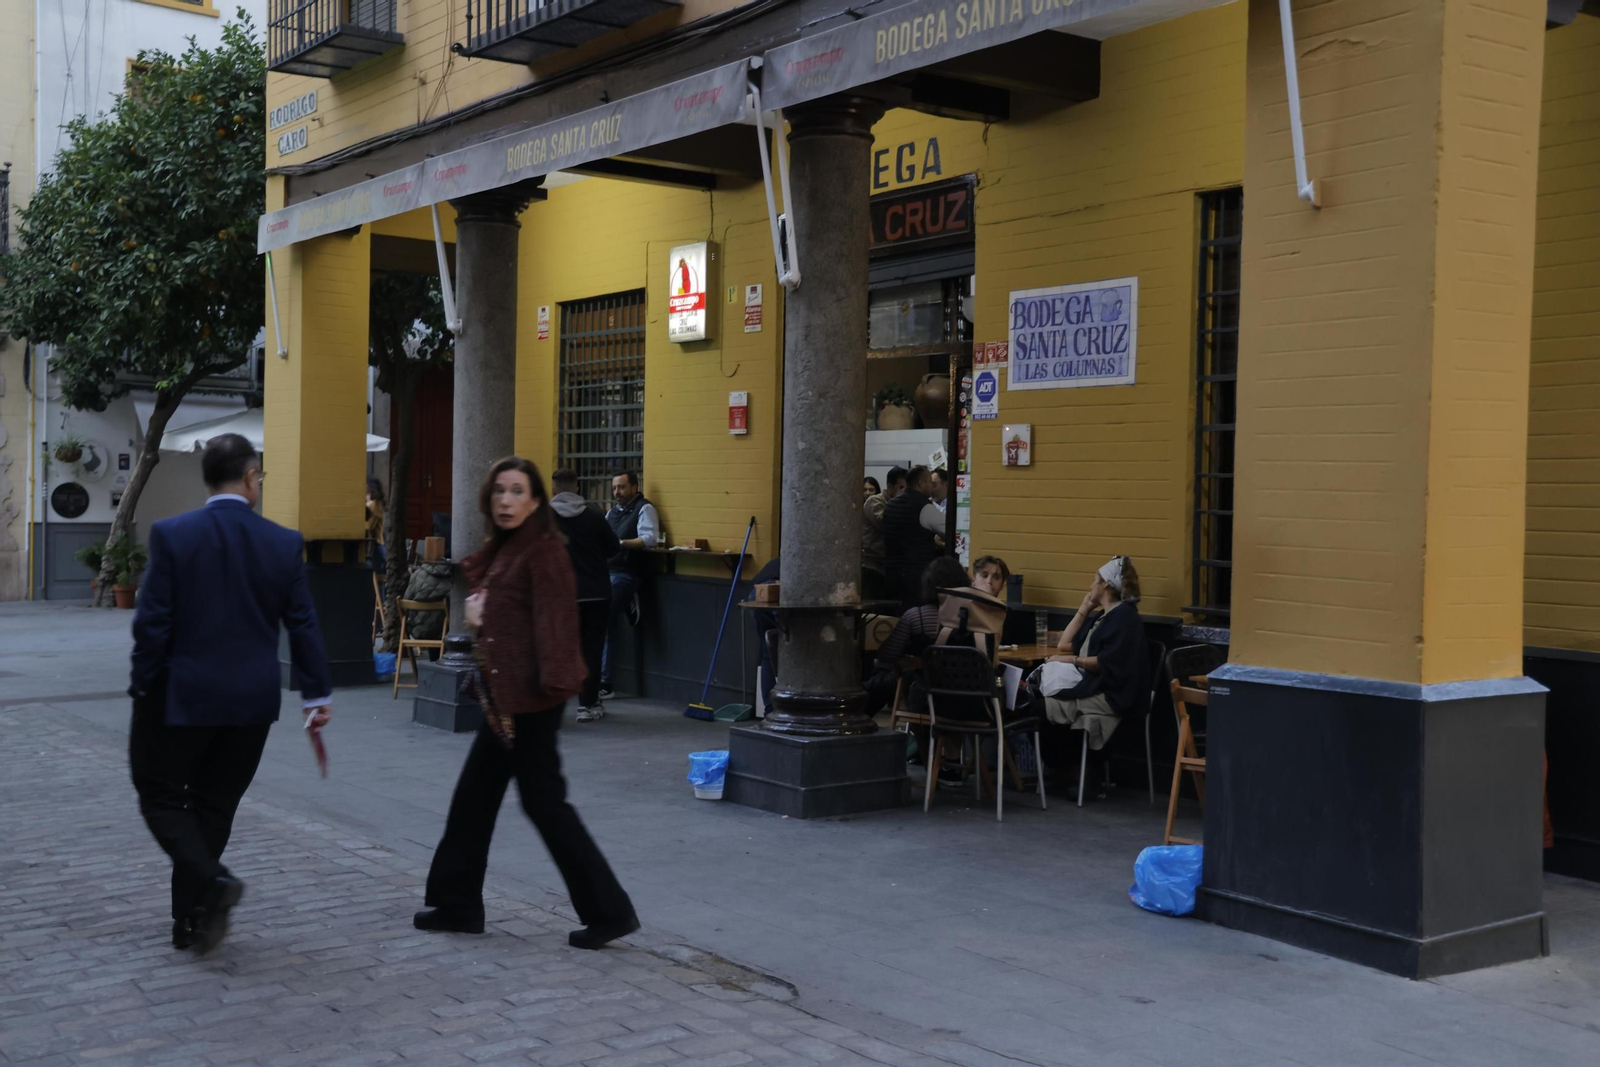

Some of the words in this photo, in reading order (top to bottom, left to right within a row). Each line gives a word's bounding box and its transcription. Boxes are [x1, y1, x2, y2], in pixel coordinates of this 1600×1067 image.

[875, 9, 948, 64] BODEGA
[270, 93, 315, 129] RODRIGO
[278, 129, 305, 154] CARO
[507, 138, 547, 173] BODEGA
[551, 124, 586, 161] SANTA
[590, 114, 622, 149] CRUZ
[885, 190, 966, 240] CRUZ
[1010, 295, 1095, 330] BODEGA
[1016, 329, 1068, 361] SANTA
[1073, 324, 1128, 356] CRUZ
[1025, 363, 1048, 380] LAS
[1053, 357, 1115, 378] COLUMNAS
[978, 381, 994, 394] ADT
